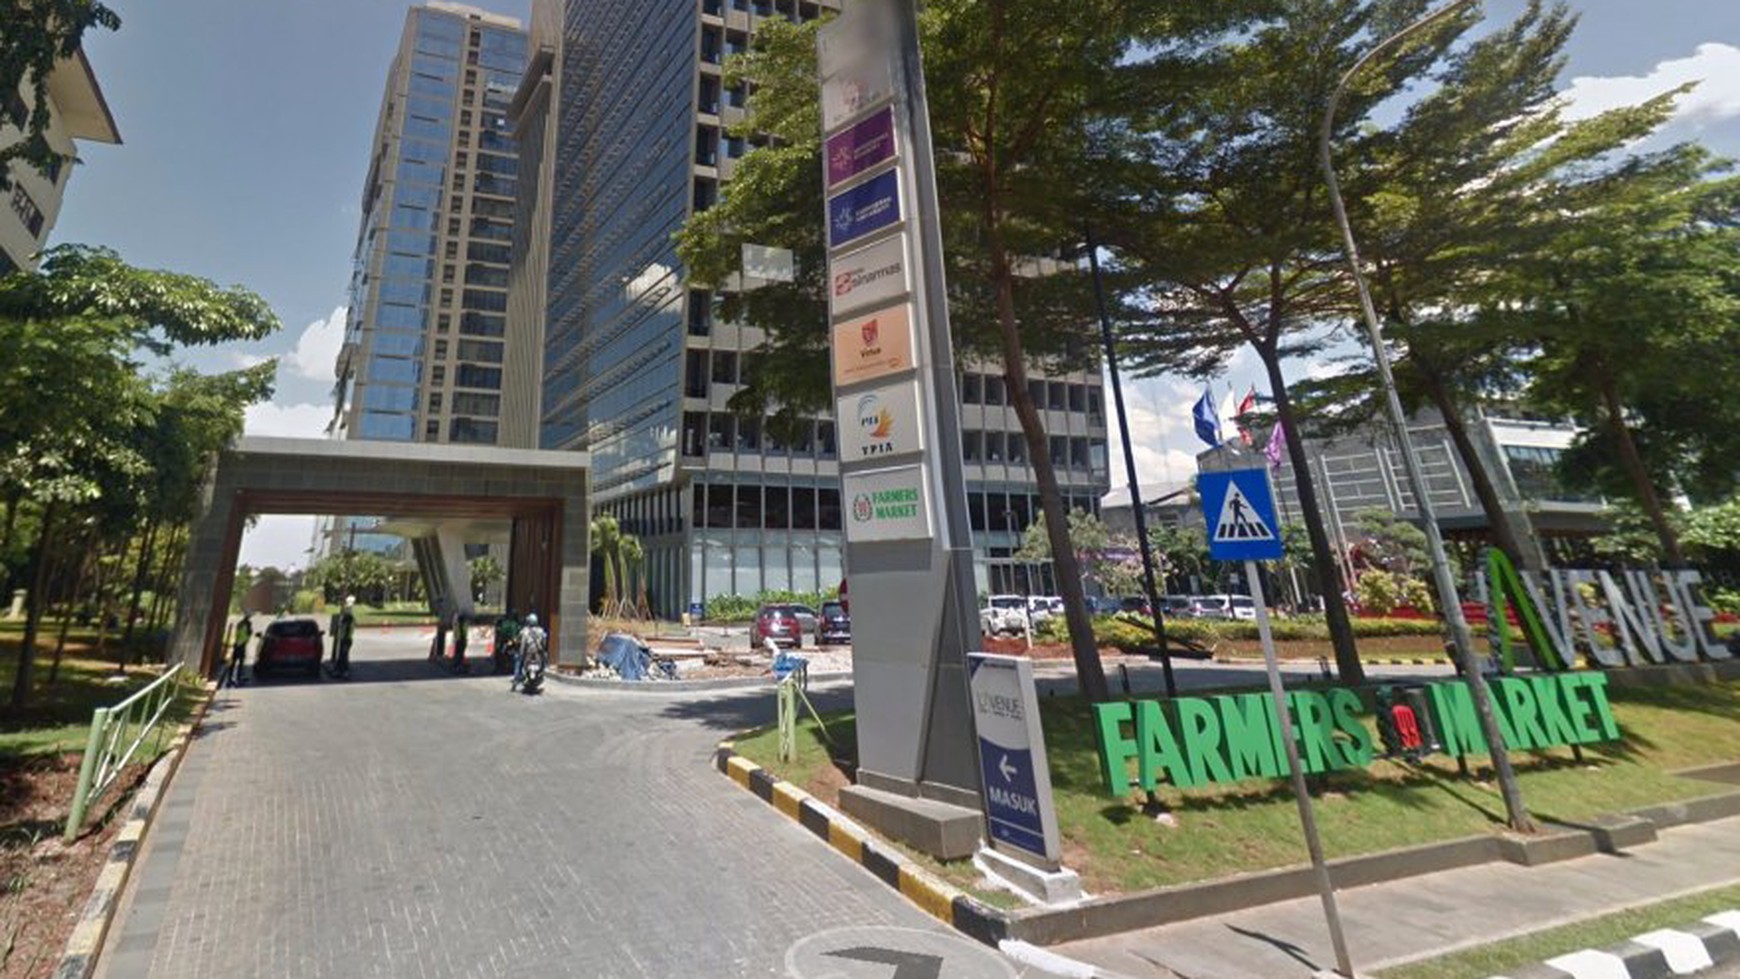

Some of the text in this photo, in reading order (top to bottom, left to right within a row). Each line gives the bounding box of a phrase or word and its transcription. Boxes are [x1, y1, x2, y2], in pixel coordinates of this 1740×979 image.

[861, 442, 893, 456] YPIA
[872, 488, 918, 504] FARMERS
[875, 504, 918, 519] MARKET
[1092, 671, 1621, 797] FARMERS MARKET
[988, 786, 1038, 817] MASUK
